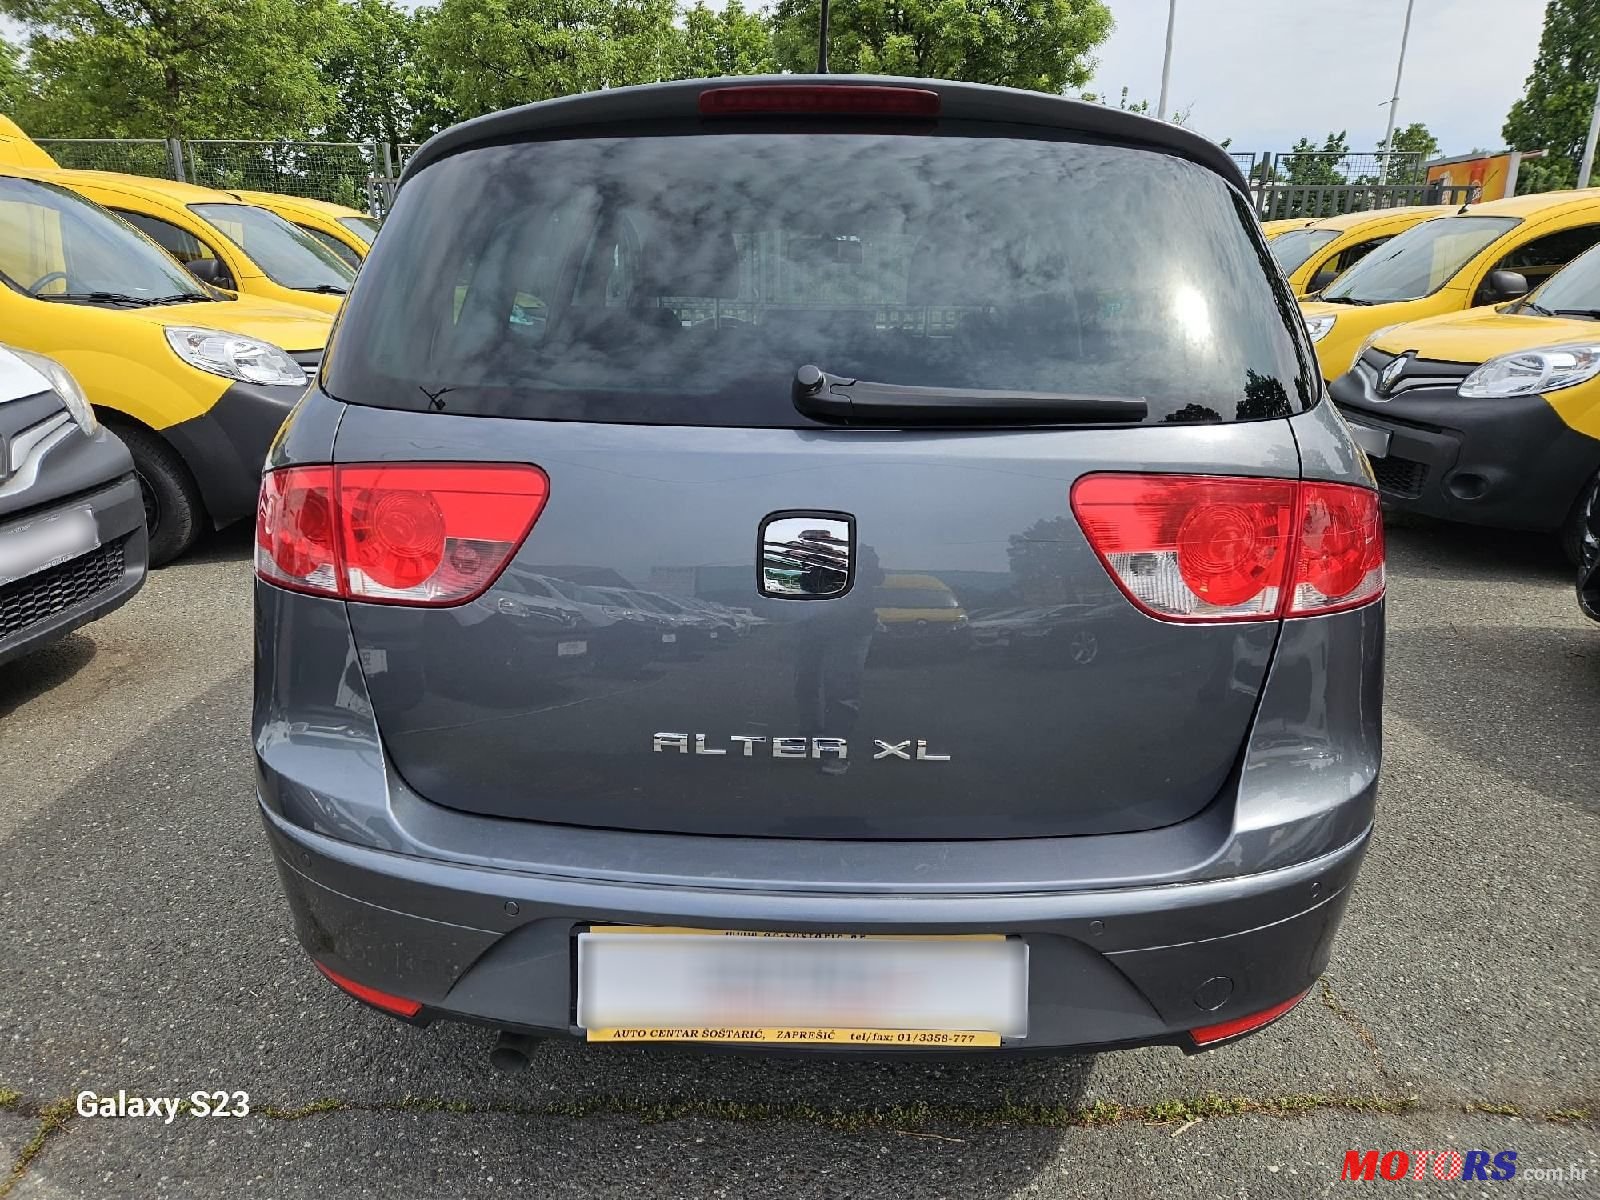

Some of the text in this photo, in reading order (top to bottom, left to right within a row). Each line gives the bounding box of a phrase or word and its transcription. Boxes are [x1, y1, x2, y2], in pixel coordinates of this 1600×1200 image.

[653, 731, 951, 761] ALTER XL
[613, 1028, 647, 1039] AUTO
[649, 1028, 699, 1039] CENTAR
[776, 1029, 836, 1041] ZAPREŠIĆ
[850, 1033, 894, 1043] tel/fax:
[897, 1033, 976, 1044] 01/3358-777
